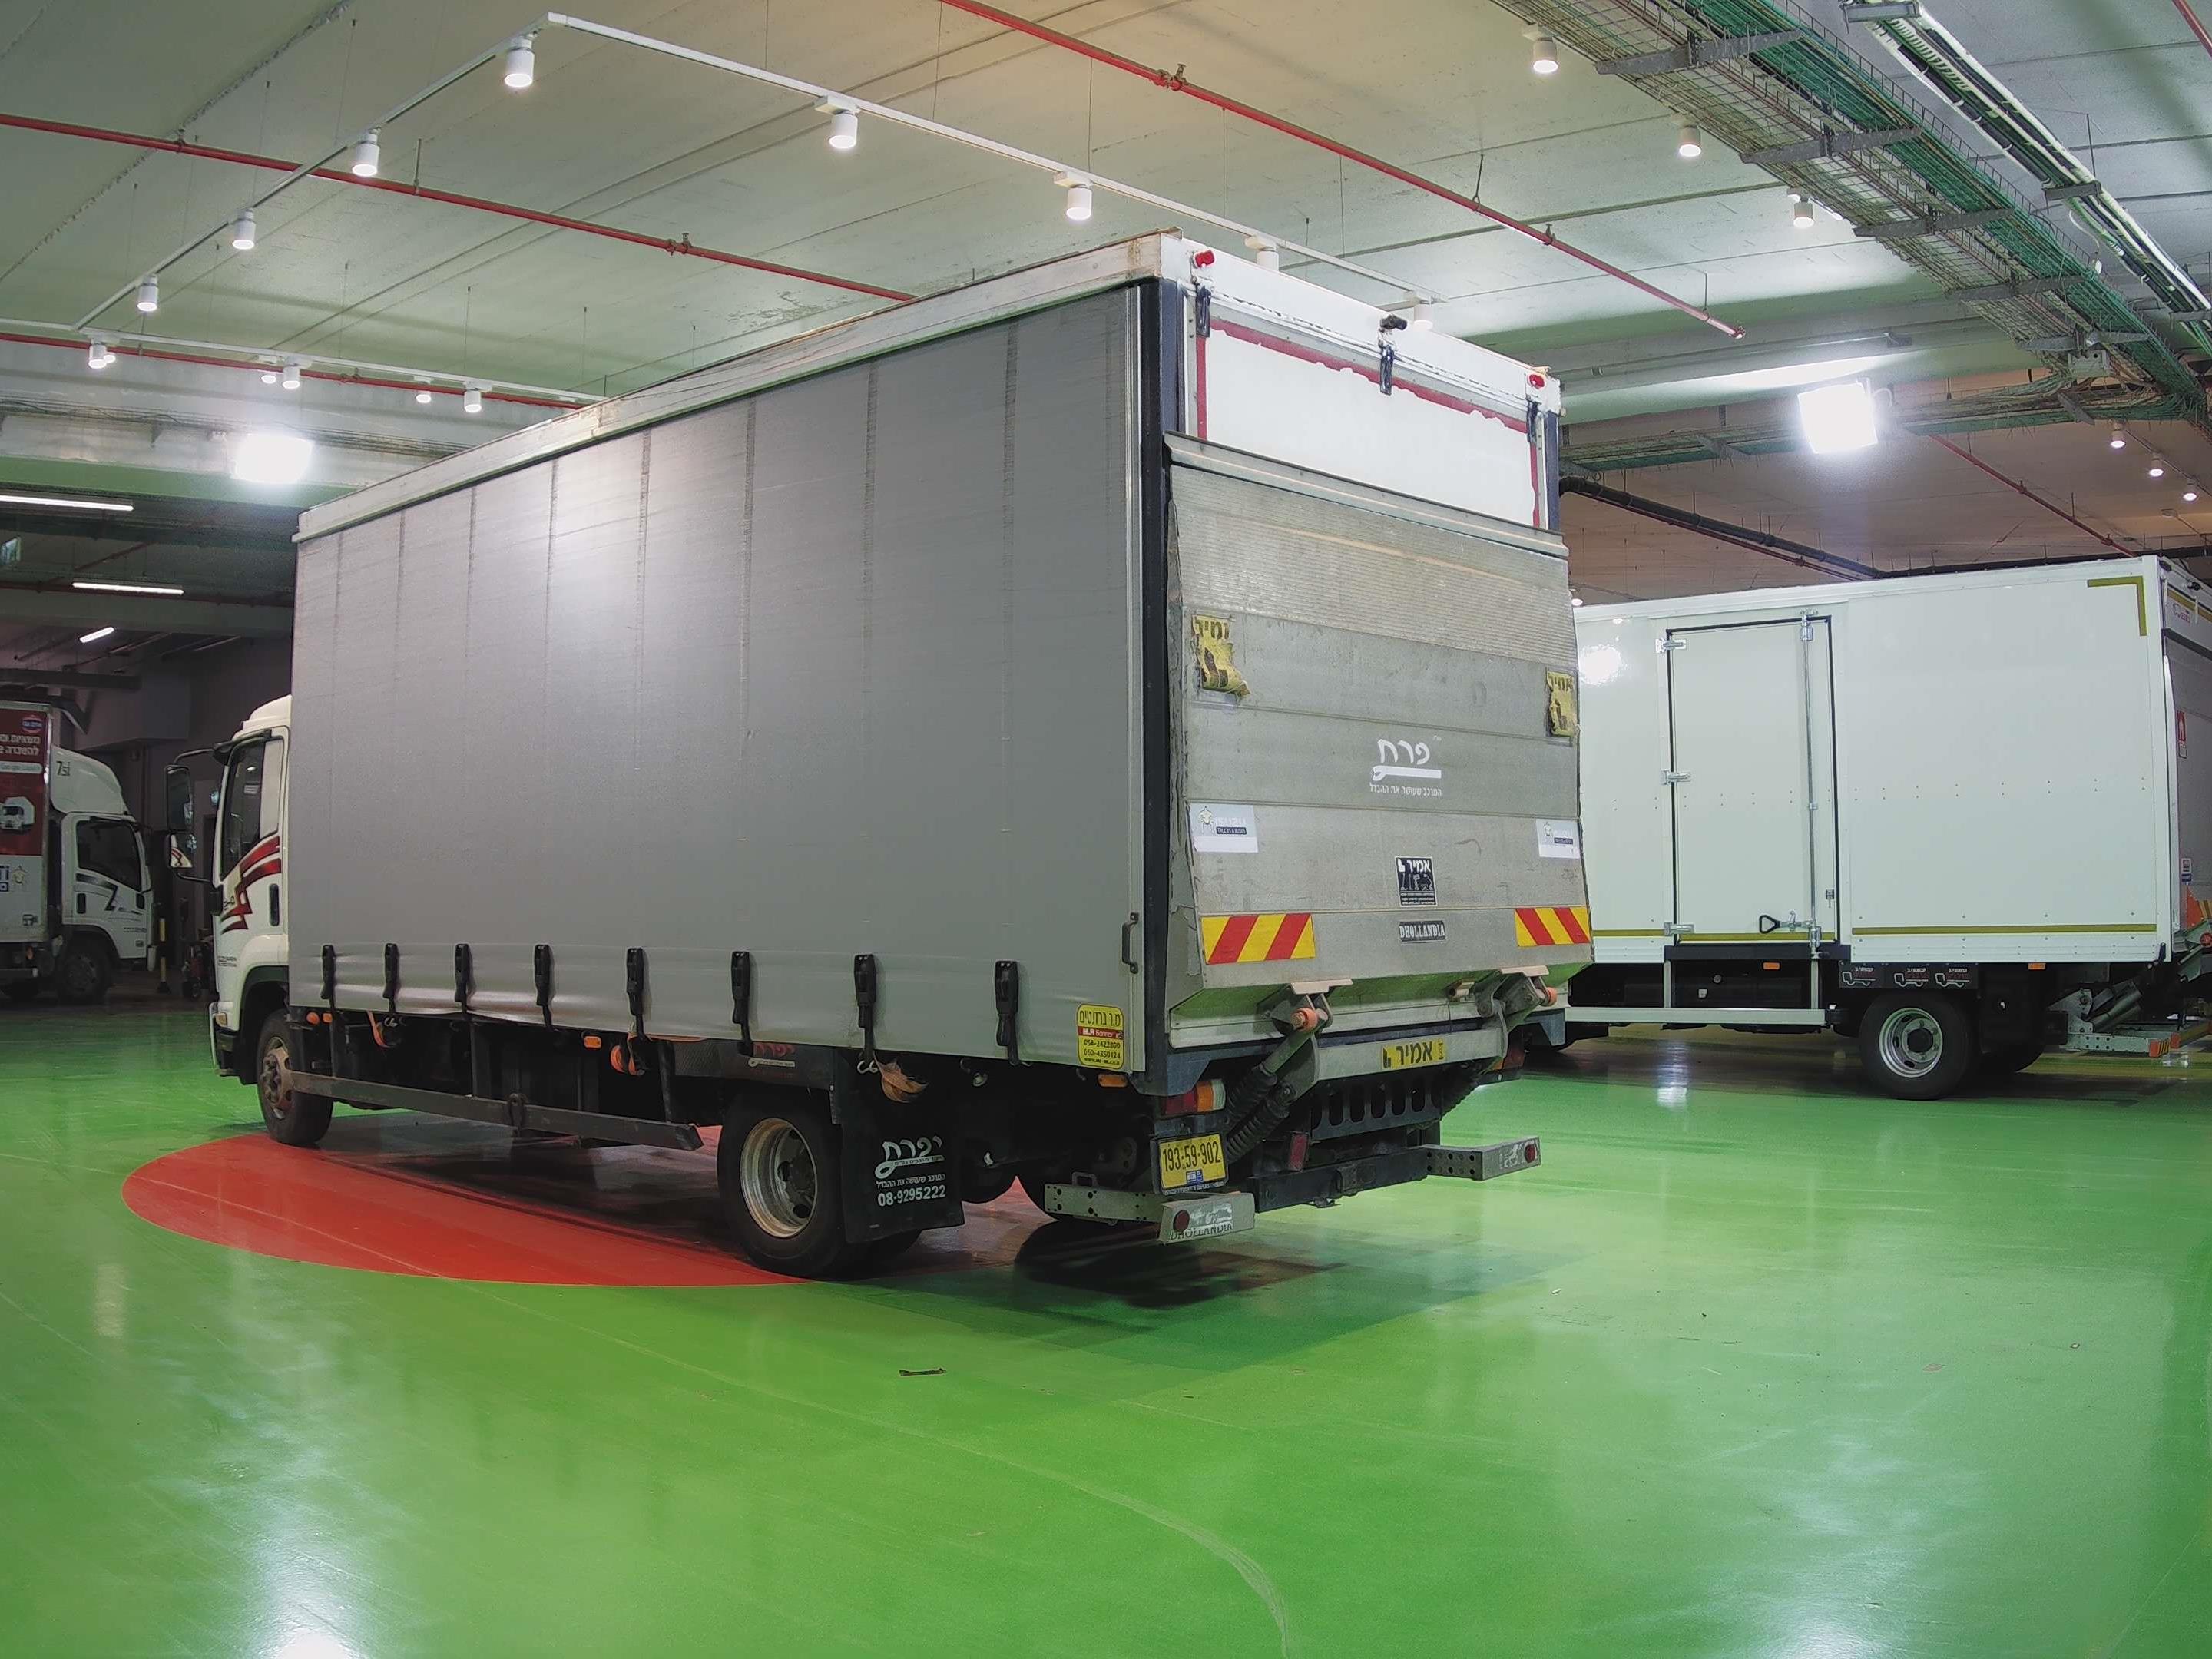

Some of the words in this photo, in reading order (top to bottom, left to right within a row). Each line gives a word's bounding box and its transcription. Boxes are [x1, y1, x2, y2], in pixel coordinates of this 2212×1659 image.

[1195, 616, 1230, 639] מיר
[1369, 782, 1389, 793] ההבדל
[1390, 786, 1399, 794] את
[1406, 859, 1431, 873] אמיר
[1399, 924, 1445, 939] DHOLLANDIA
[1396, 1041, 1433, 1065] אמיר
[1162, 1141, 1221, 1172] 193-59-902
[877, 1184, 946, 1207] 08-9295222
